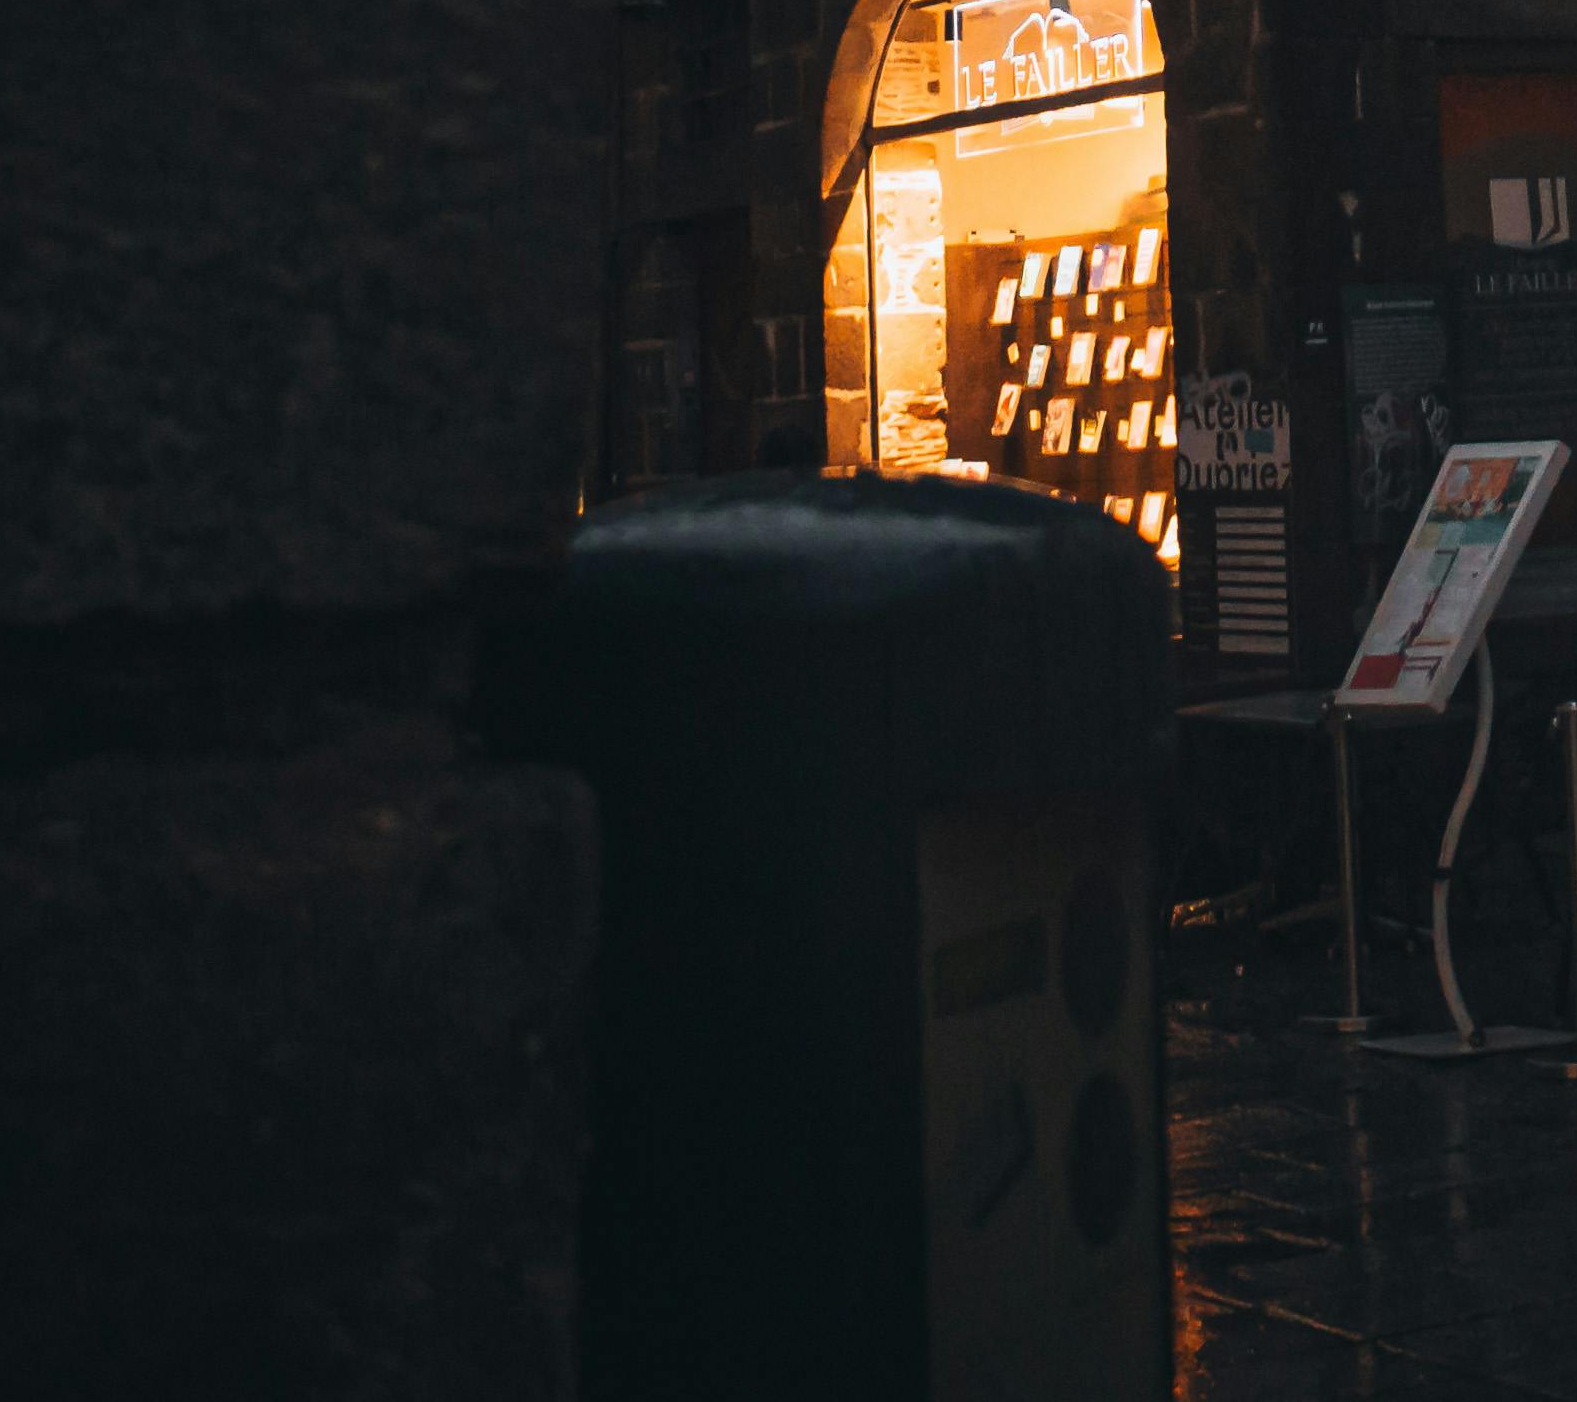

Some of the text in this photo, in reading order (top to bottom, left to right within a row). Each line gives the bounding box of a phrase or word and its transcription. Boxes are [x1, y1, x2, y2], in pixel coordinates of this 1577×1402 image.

[960, 32, 1135, 109] LE FAILLER
[1475, 273, 1496, 295] LE
